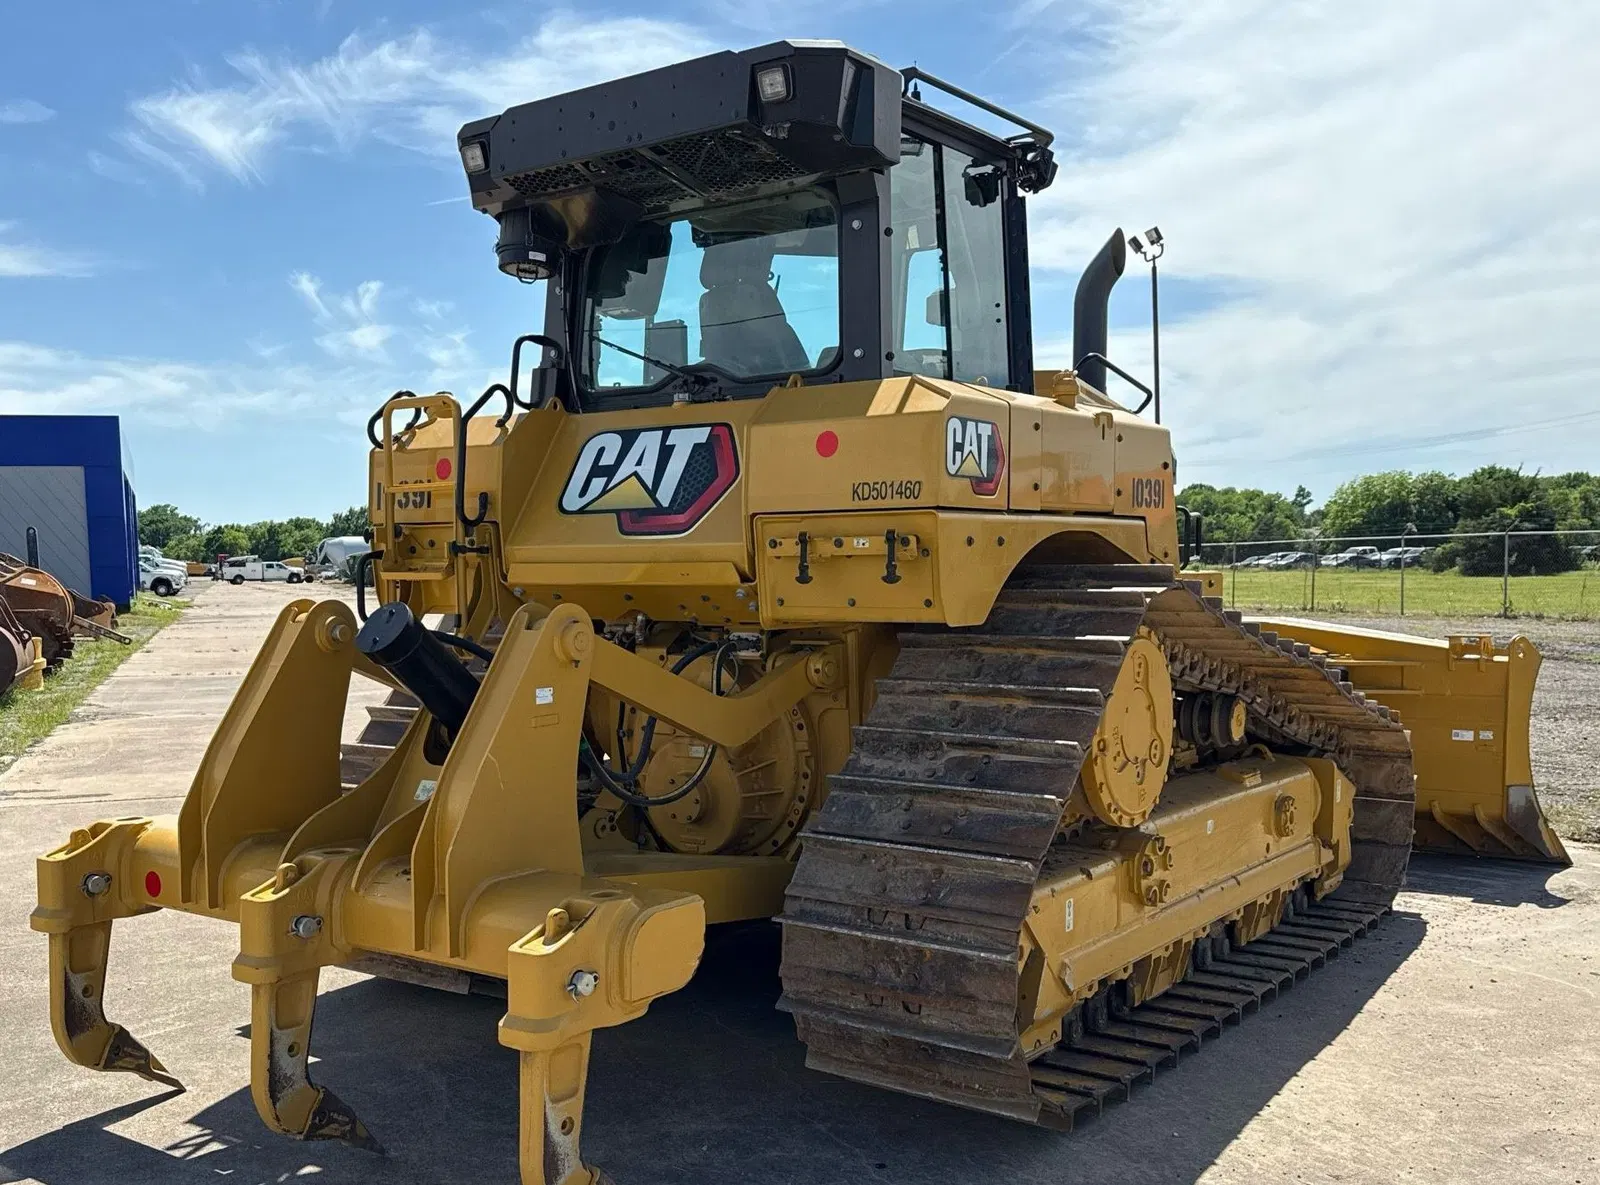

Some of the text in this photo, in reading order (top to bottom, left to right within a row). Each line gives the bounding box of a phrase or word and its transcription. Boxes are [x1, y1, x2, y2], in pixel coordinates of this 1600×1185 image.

[947, 417, 992, 478] CAT
[562, 426, 712, 512] CAT
[377, 479, 432, 511] 1391
[852, 480, 922, 501] KD501460
[1132, 477, 1165, 509] 10391
